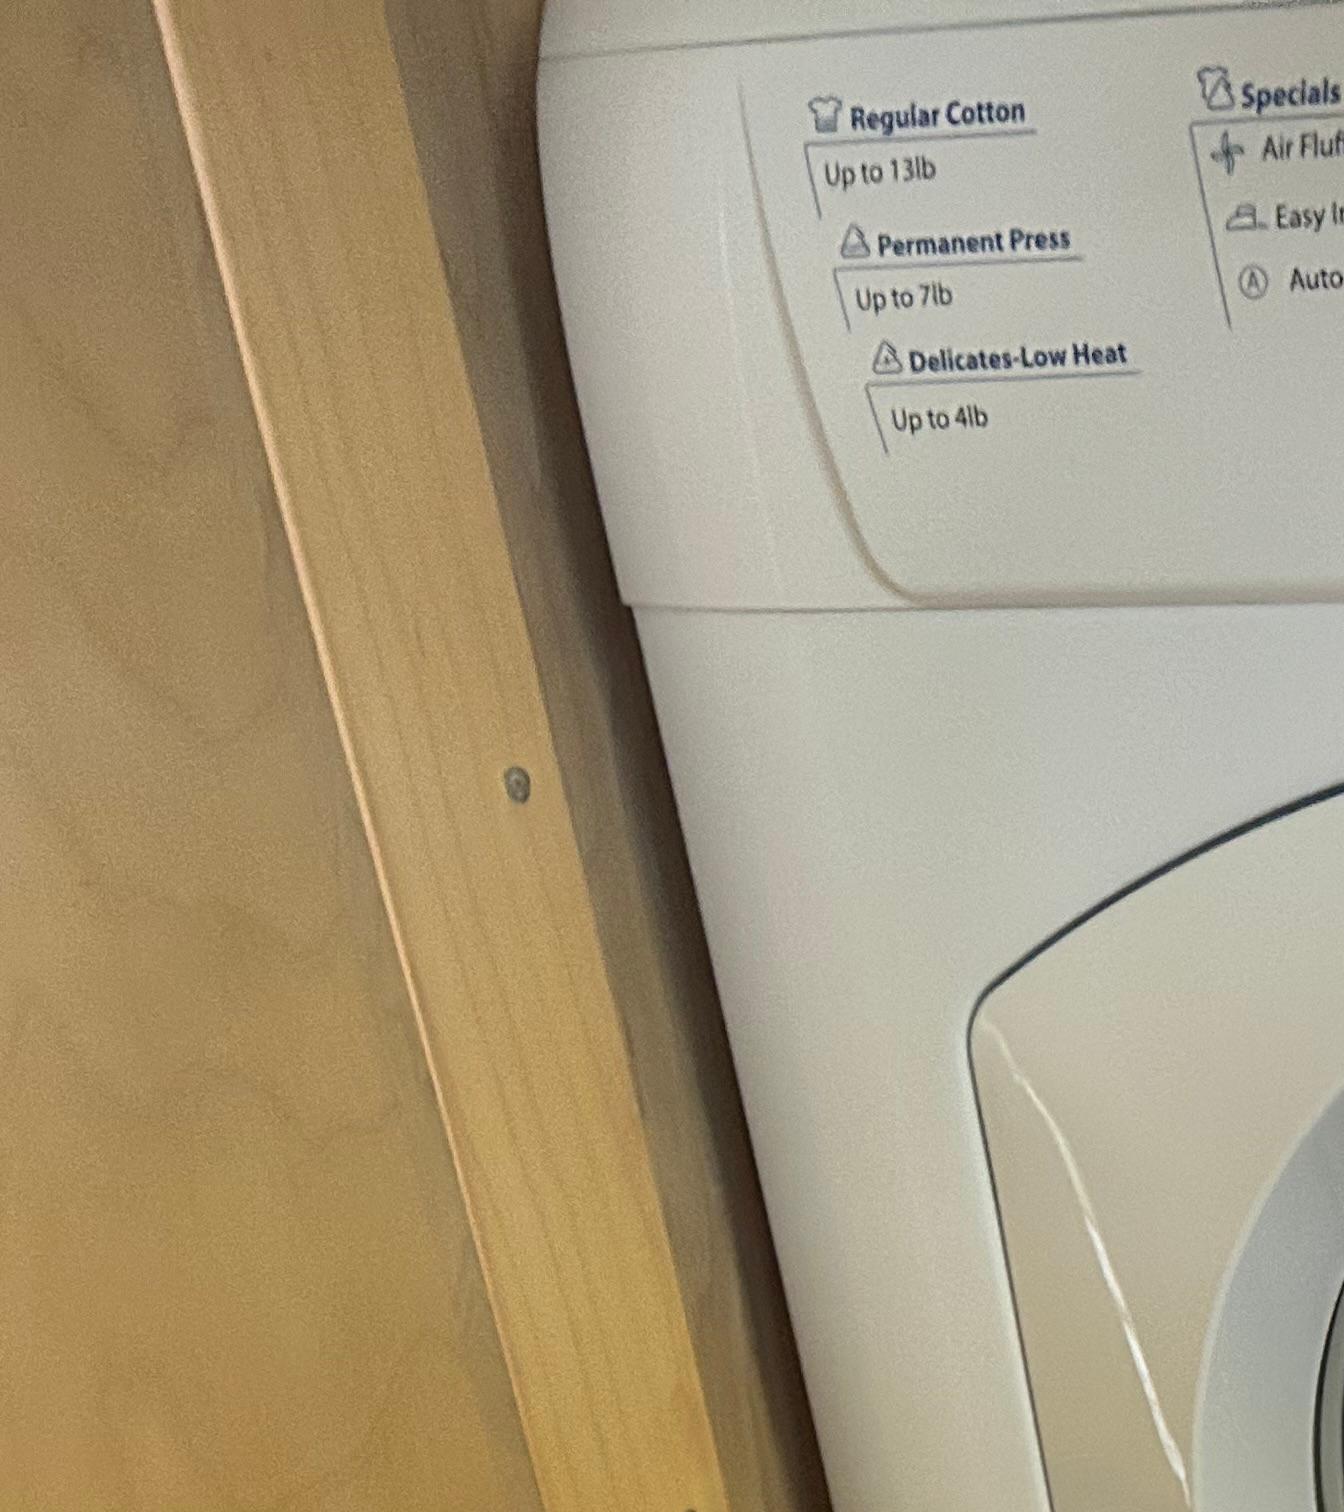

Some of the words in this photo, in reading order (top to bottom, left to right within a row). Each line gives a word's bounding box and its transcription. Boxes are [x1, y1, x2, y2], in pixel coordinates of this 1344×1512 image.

[1241, 77, 1342, 115] Specials
[850, 102, 940, 135] Regular
[945, 100, 1025, 126] Cotton
[1262, 132, 1294, 162] Air
[824, 160, 856, 192] Up
[861, 160, 884, 184] to
[889, 155, 937, 182] 13lb
[1275, 202, 1325, 233] Easy
[877, 231, 1003, 258] Permanent
[1008, 228, 1072, 251] Press
[1289, 267, 1343, 292] Auto
[855, 287, 887, 316] Up
[892, 287, 914, 308] to
[919, 281, 953, 307] 7lb
[908, 345, 1067, 374] Delicates-Low
[1072, 342, 1127, 367] Heat
[891, 408, 923, 435] Up
[928, 409, 950, 430] to
[954, 405, 988, 430] 4lb
